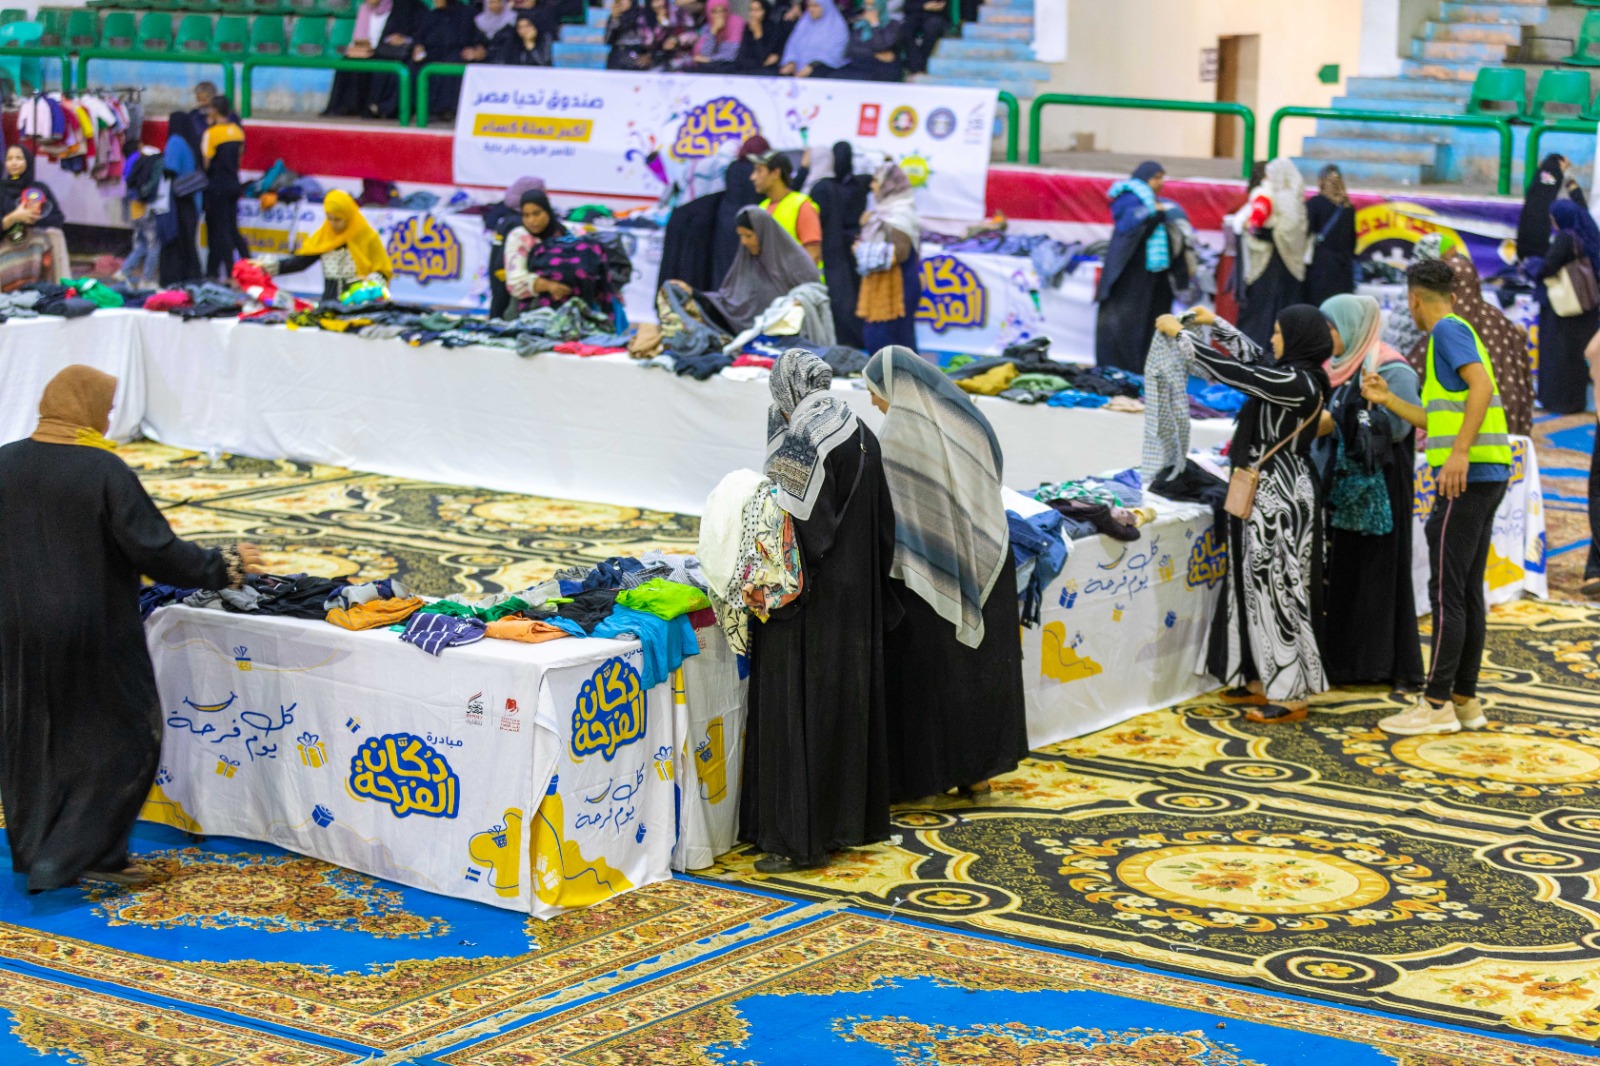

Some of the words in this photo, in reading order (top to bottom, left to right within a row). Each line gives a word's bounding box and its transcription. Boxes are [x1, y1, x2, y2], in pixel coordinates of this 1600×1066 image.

[473, 92, 509, 106] مصر
[513, 89, 543, 109] تحيا
[546, 92, 604, 110] صندوق
[521, 121, 555, 136] حملة
[167, 710, 242, 743] فرحة
[246, 735, 278, 762] يوم
[426, 731, 463, 749] مبادرة
[575, 801, 613, 829] فرحة
[615, 806, 636, 834] يوم
